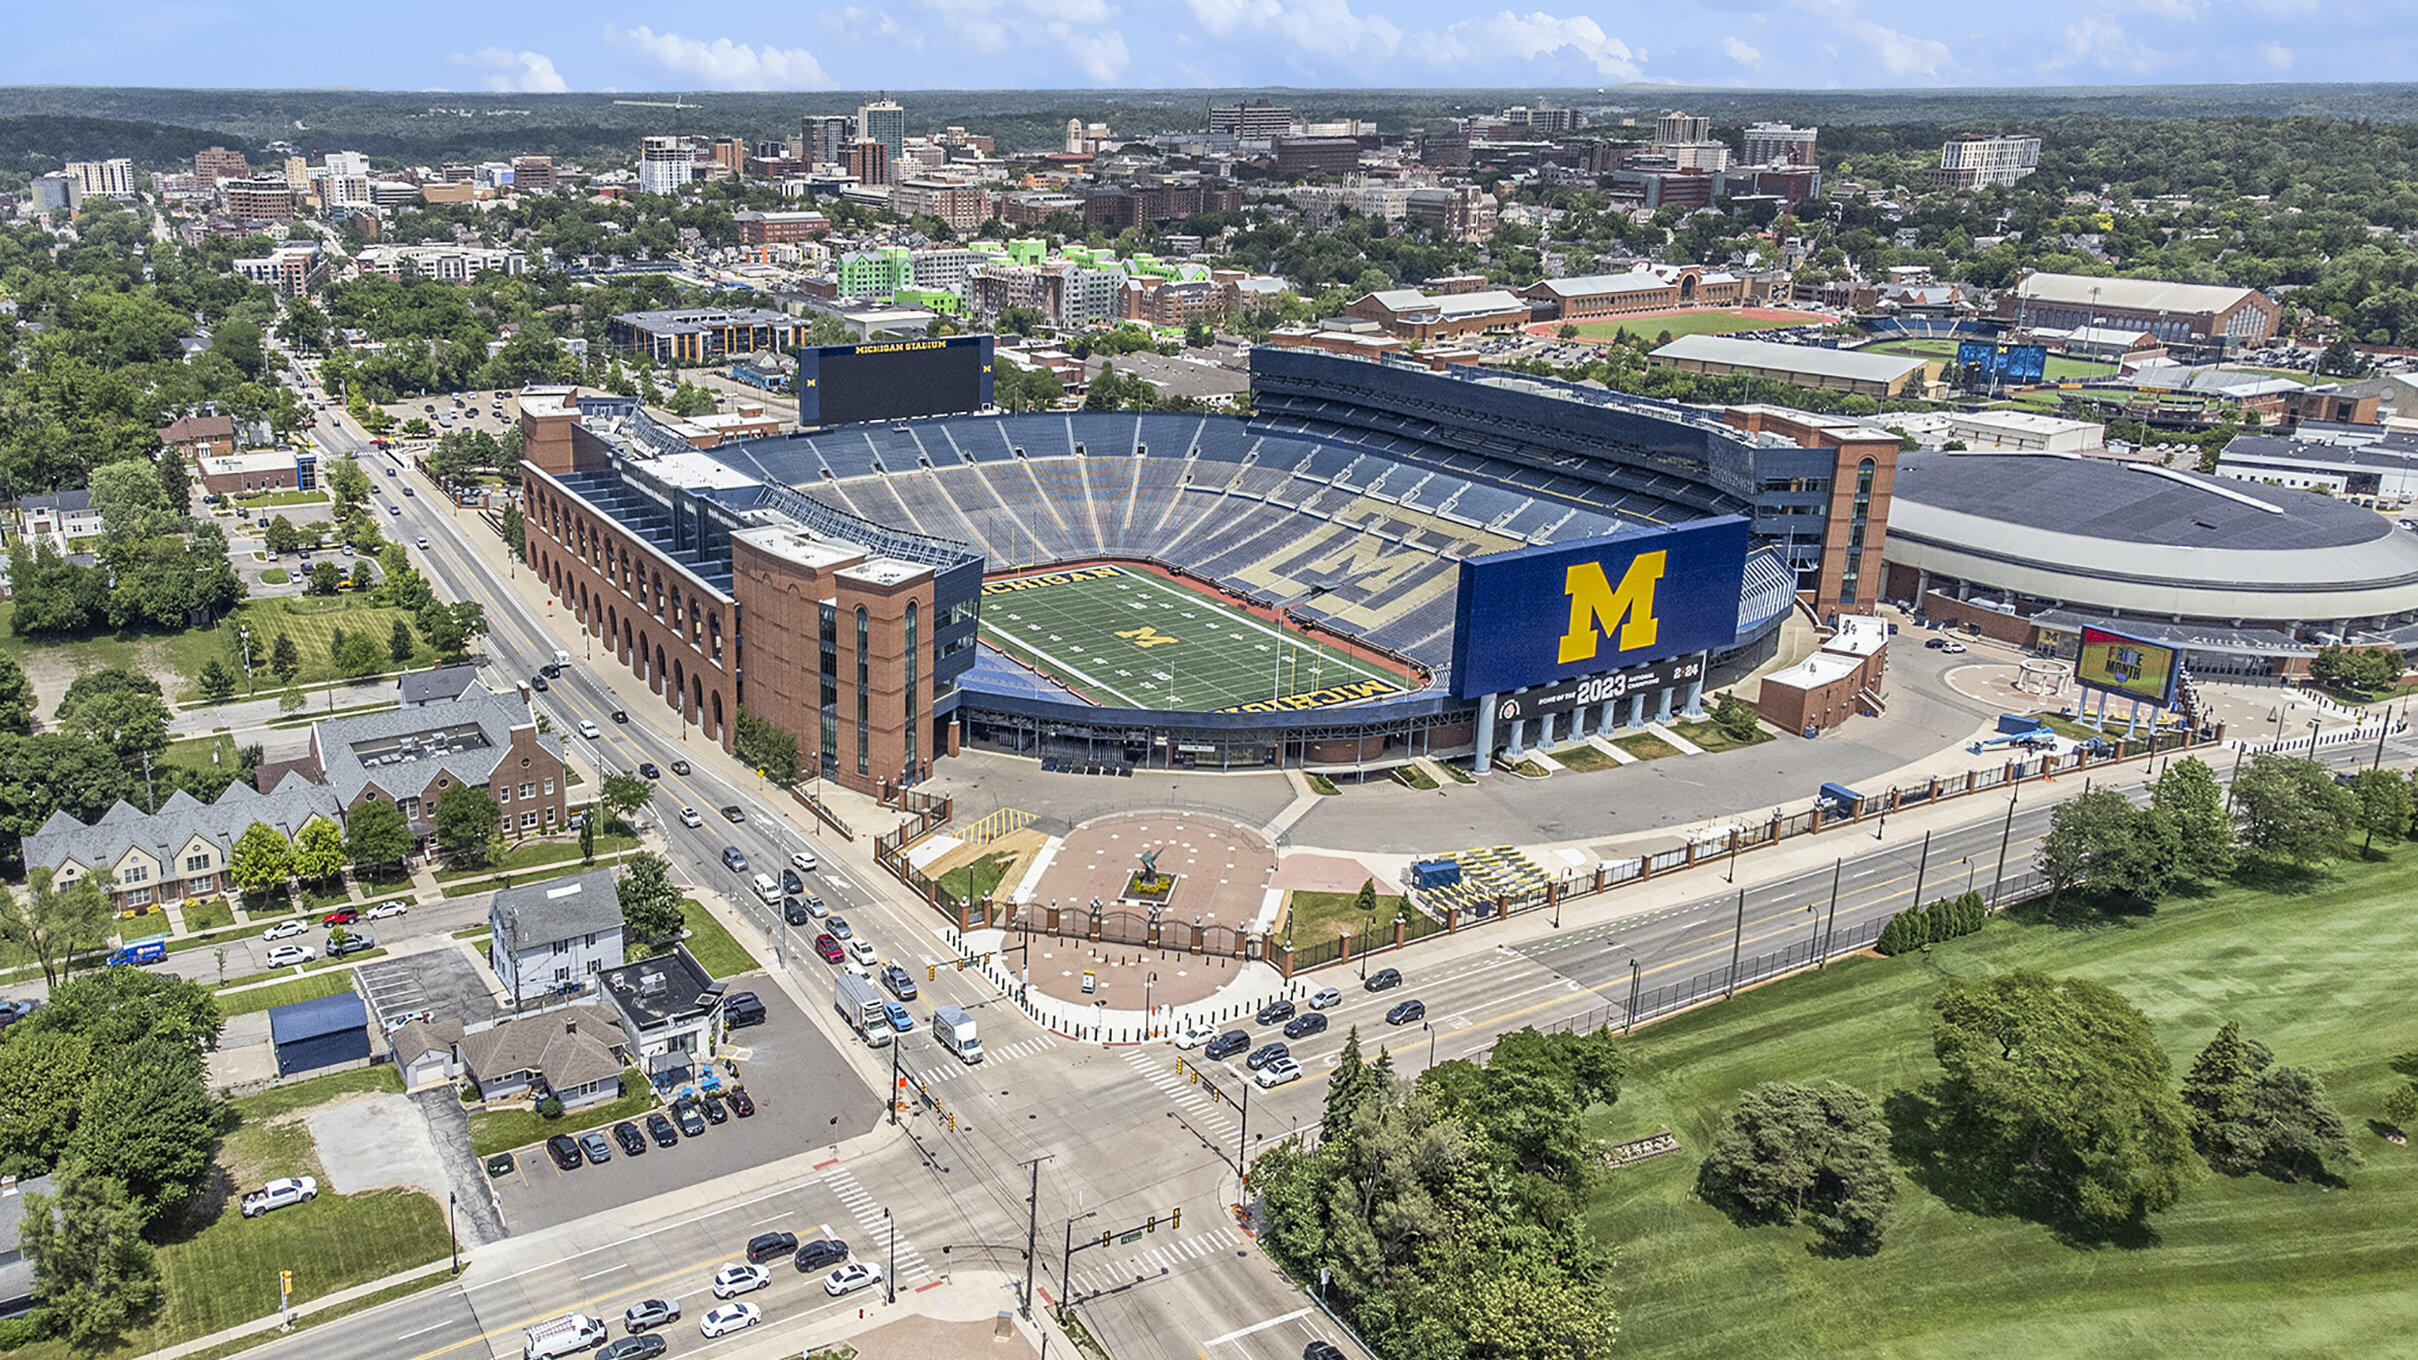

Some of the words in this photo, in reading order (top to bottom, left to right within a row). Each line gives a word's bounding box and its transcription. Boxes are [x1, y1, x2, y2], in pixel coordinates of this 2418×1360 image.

[855, 343, 904, 354] MICHIGAN
[905, 340, 946, 350] STADIUM
[1998, 346, 2008, 354] M
[982, 364, 991, 373] M
[806, 379, 816, 387] M
[1557, 549, 1667, 664] M
[1114, 626, 1179, 648] M
[2108, 645, 2144, 666] PRIDE
[2105, 659, 2142, 680] MONTH
[1577, 674, 1627, 705] 2023
